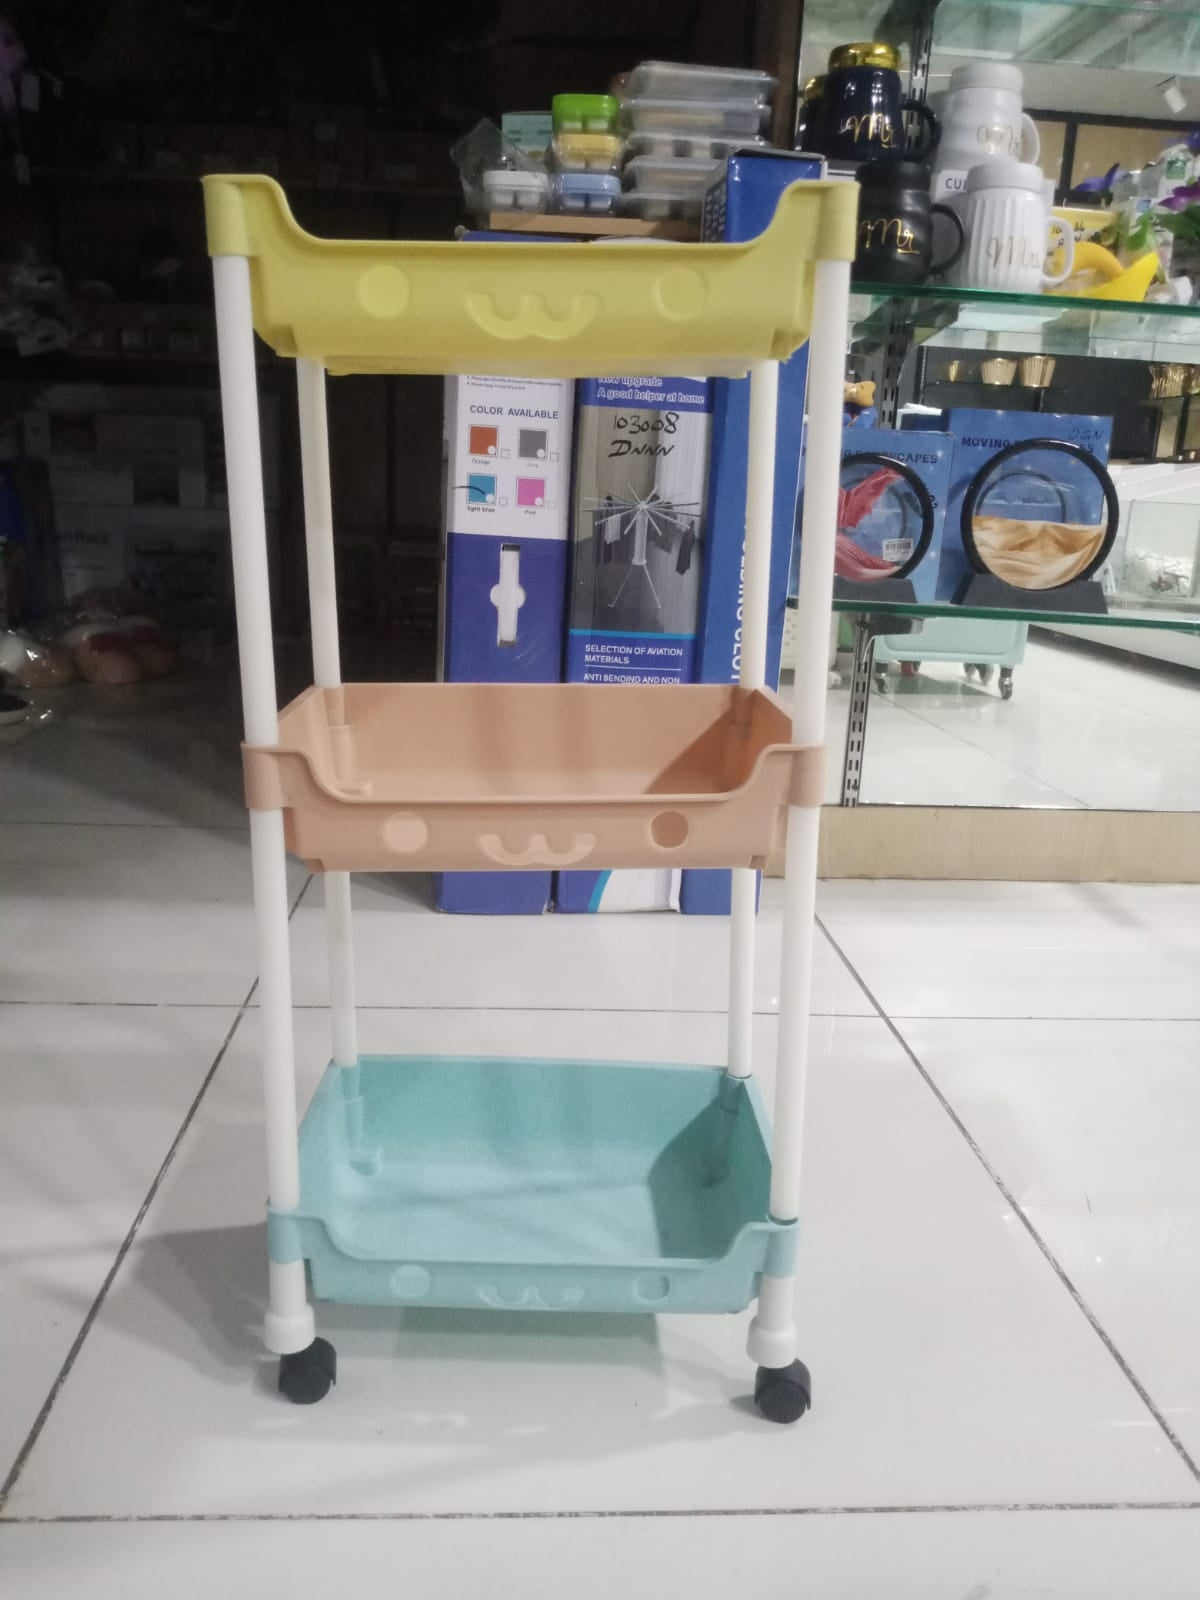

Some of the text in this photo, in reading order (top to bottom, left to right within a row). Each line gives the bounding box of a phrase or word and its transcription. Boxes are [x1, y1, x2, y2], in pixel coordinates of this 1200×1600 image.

[945, 177, 967, 190] CU
[621, 377, 662, 387] upgrade
[597, 388, 705, 404] A good helper at home
[469, 405, 559, 419] COLOR AVAILABLE
[613, 411, 679, 434] 103008
[962, 436, 1010, 448] MOVING
[585, 644, 683, 656] SELECTION OF AVIATION
[585, 655, 630, 664] MATERIALS
[584, 673, 602, 681] ANTI
[603, 674, 641, 683] BENDING
[642, 676, 660, 684] AND
